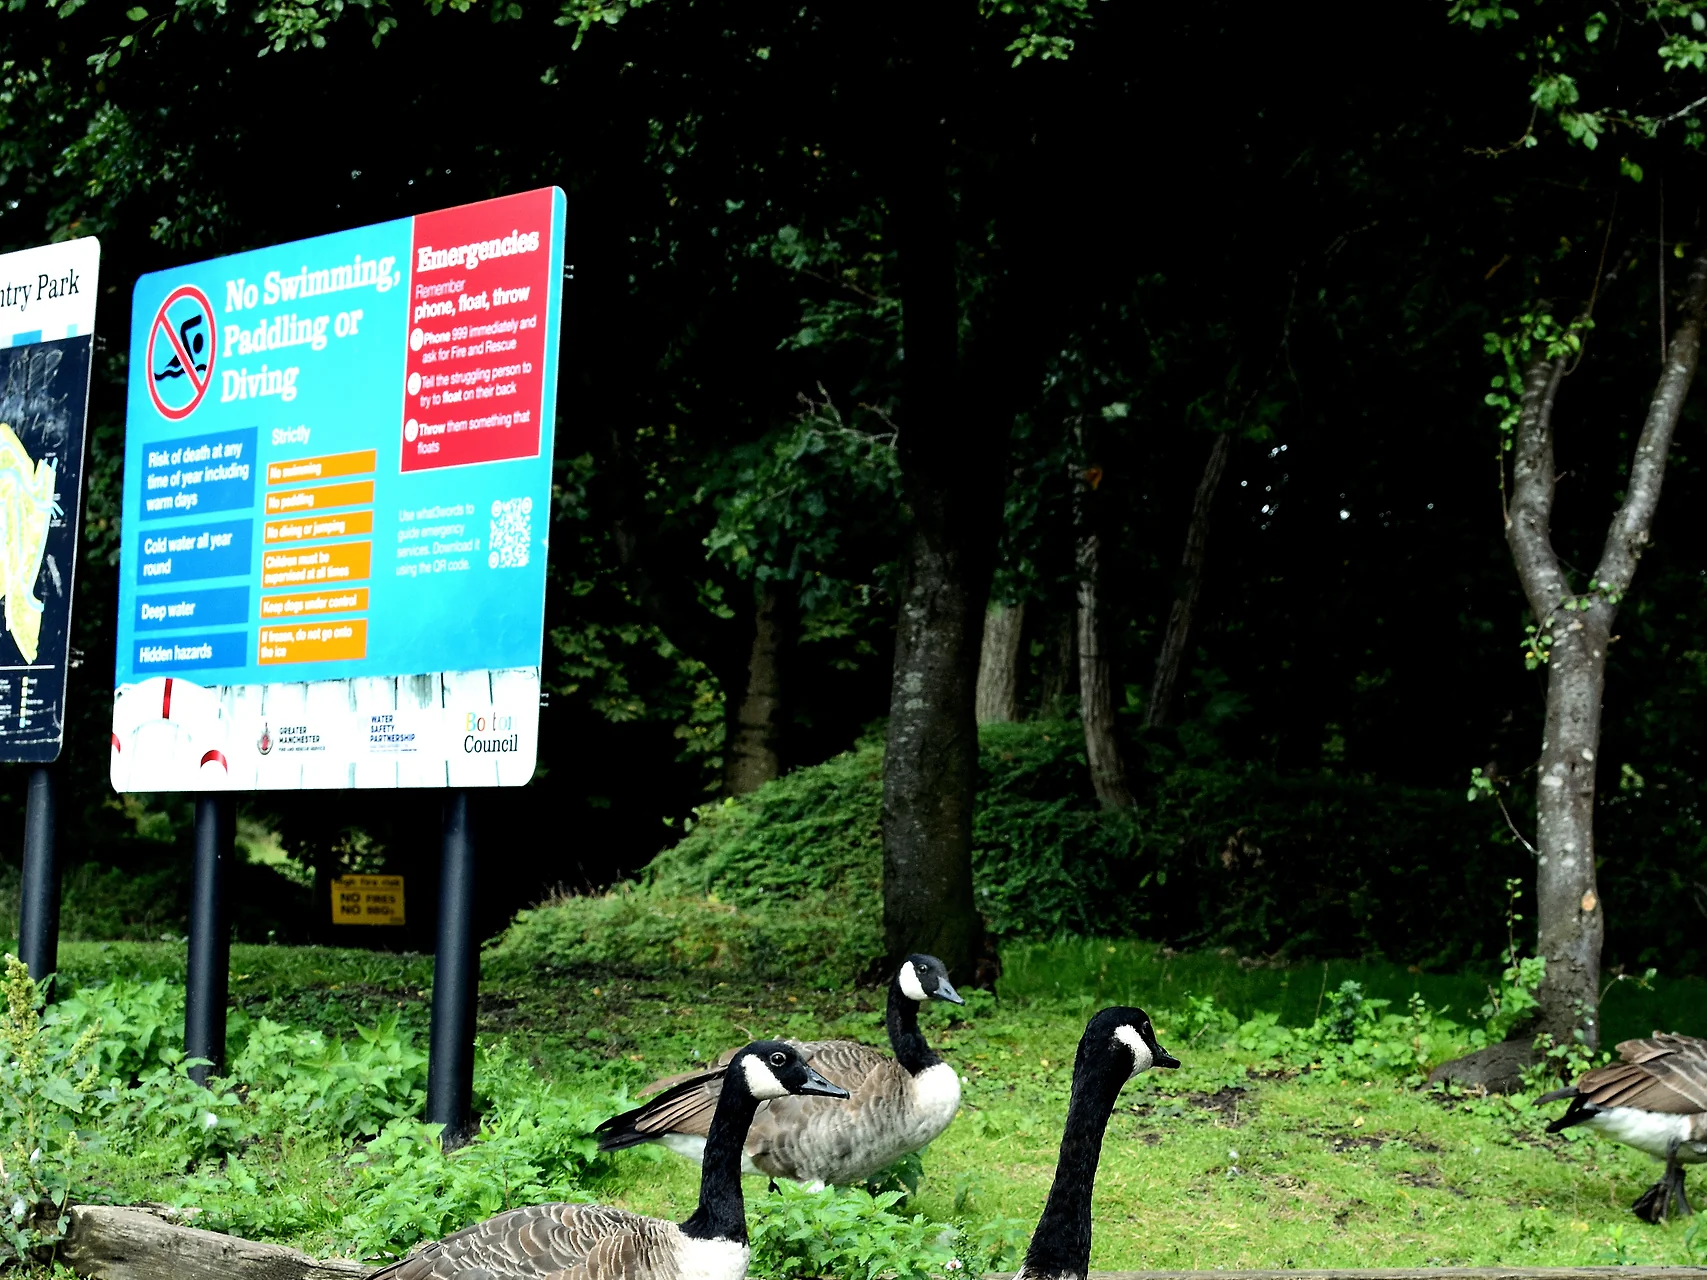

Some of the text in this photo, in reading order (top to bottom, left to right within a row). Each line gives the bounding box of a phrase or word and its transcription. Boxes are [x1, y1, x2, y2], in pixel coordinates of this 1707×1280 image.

[416, 229, 540, 273] Emergencies
[37, 268, 79, 301] Park
[225, 254, 401, 313] No Swimming,
[415, 279, 466, 299] Remember
[414, 286, 531, 323] phone, float, throw
[223, 309, 363, 358] Paddling or
[423, 314, 537, 346] Phone 999 immediately and
[422, 338, 517, 364] ask for Fire and Rescue
[220, 363, 299, 403] Diving
[421, 360, 532, 389] Tell the struggling person to
[420, 381, 517, 409] try to float on their back
[419, 410, 531, 436] Throw them something that
[271, 424, 311, 446] Strictly
[148, 443, 243, 469] Risk of death at any
[417, 441, 440, 455] floats
[147, 462, 249, 490] time of year including
[269, 462, 322, 479] No swimming
[146, 492, 198, 512] warm days
[268, 496, 280, 510] No
[398, 509, 415, 522] Use
[465, 503, 475, 515] to
[267, 526, 279, 539] No
[303, 525, 313, 535] or
[398, 524, 465, 543] guide emergency
[144, 532, 233, 555] Cold water all year
[432, 539, 473, 555] Download
[473, 538, 481, 551] it
[143, 558, 172, 576] round
[265, 555, 297, 569] Children
[319, 551, 330, 564] be
[396, 562, 417, 578] using
[418, 560, 432, 574] the
[432, 559, 447, 573] QR
[306, 568, 315, 580] at
[316, 566, 326, 579] all
[327, 566, 349, 578] times
[141, 601, 196, 622] Deep water
[263, 593, 357, 615] Keep dogs under control
[295, 629, 307, 641] do
[307, 628, 321, 640] not
[321, 629, 333, 642] go
[333, 625, 353, 638] onto
[140, 642, 212, 663] Hidden hazards
[260, 645, 287, 658] the ice
[370, 725, 395, 733] SAFETY
[371, 715, 393, 724] WATER
[465, 712, 517, 732] Boton
[279, 726, 307, 735] GREATER
[279, 735, 320, 744] MANCHESTER
[370, 734, 415, 743] PARTNERSHIP
[464, 734, 518, 753] Council
[340, 893, 360, 903] NO
[340, 905, 361, 915] NO
